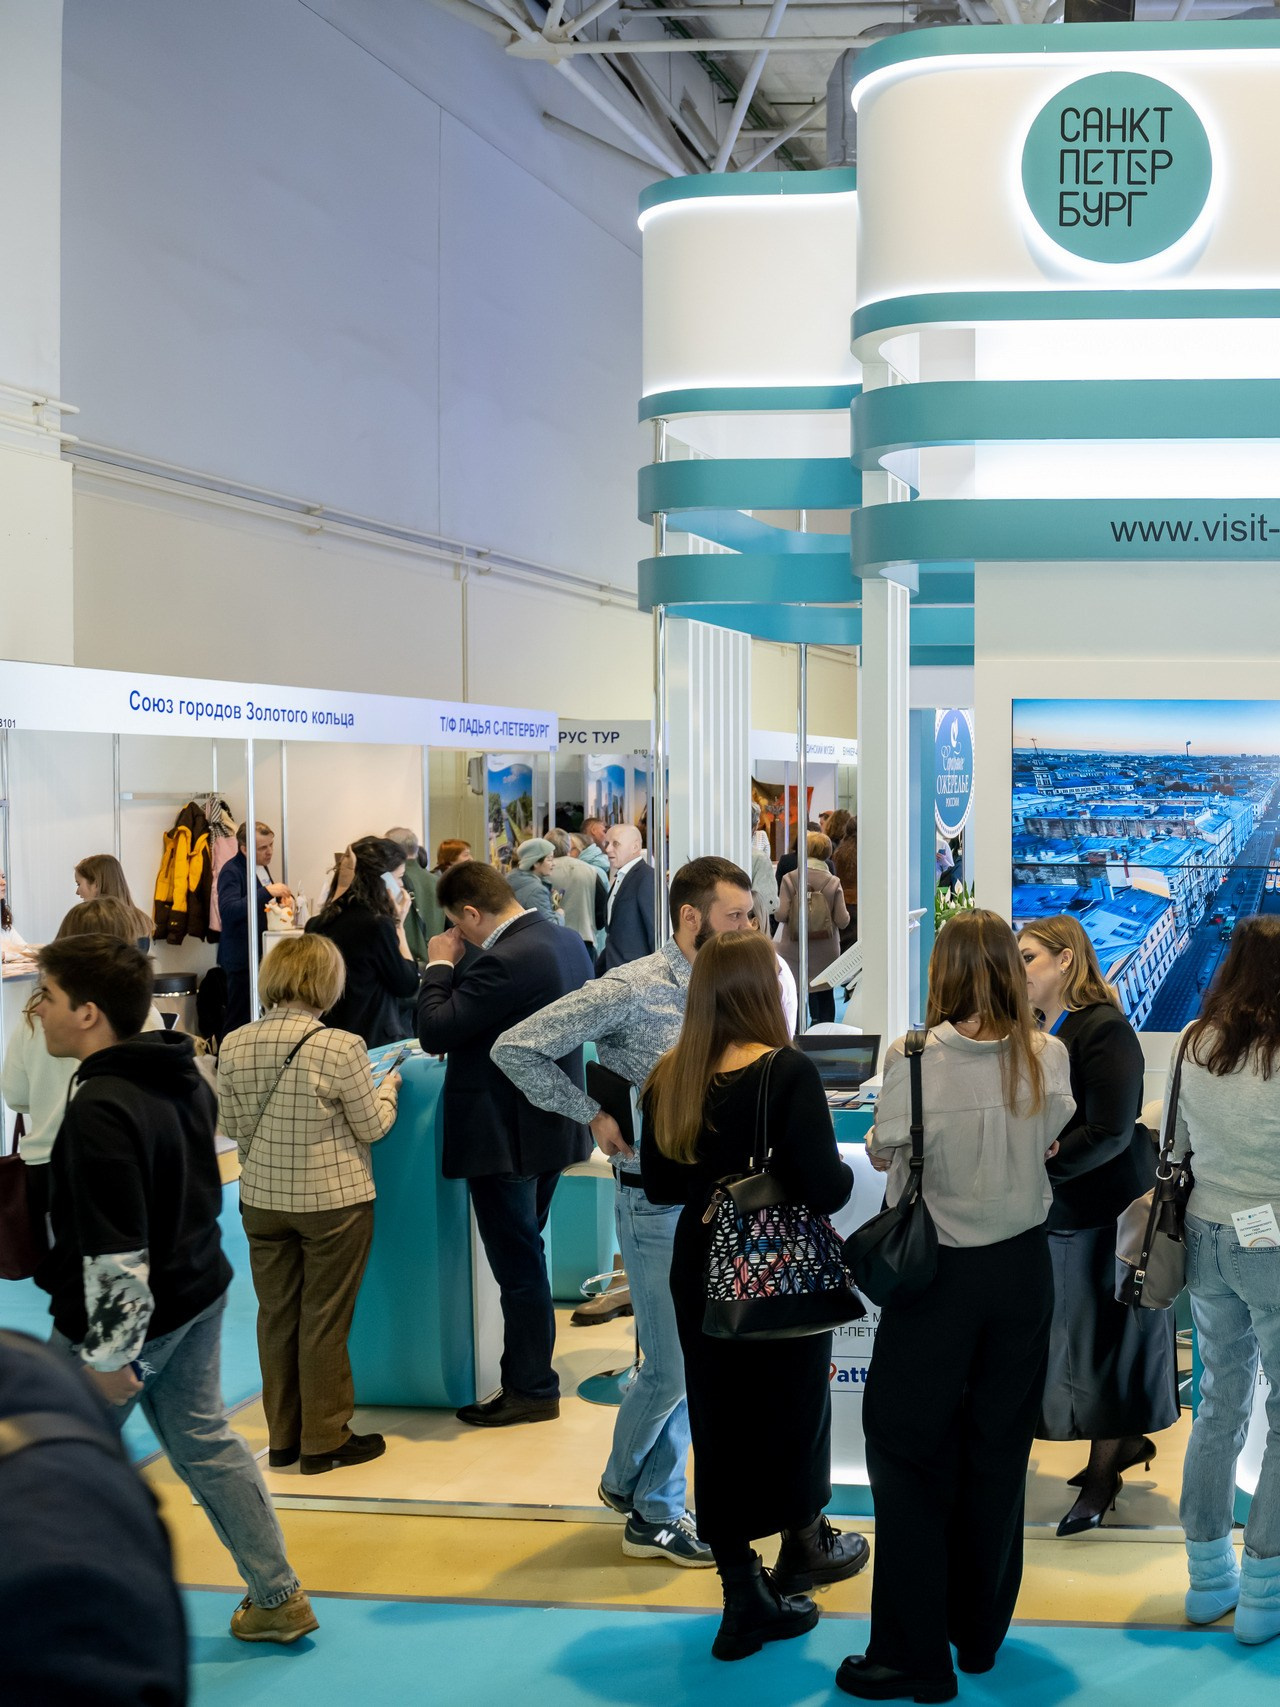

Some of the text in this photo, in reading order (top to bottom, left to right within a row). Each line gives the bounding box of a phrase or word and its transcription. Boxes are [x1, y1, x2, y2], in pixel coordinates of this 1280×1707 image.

[1060, 107, 1173, 143] САНКТ
[1059, 149, 1173, 186] ПЕТЕР
[1058, 191, 1148, 227] БУРГ
[129, 689, 354, 729] Союз городов Золотого кольца
[439, 716, 550, 738] Т/Ф ЛАДЬЯ С-ПЕТЕРБУРГ
[558, 731, 621, 744] РУС ТУР
[936, 774, 970, 795] ОЖЕРЕЛЬЕ
